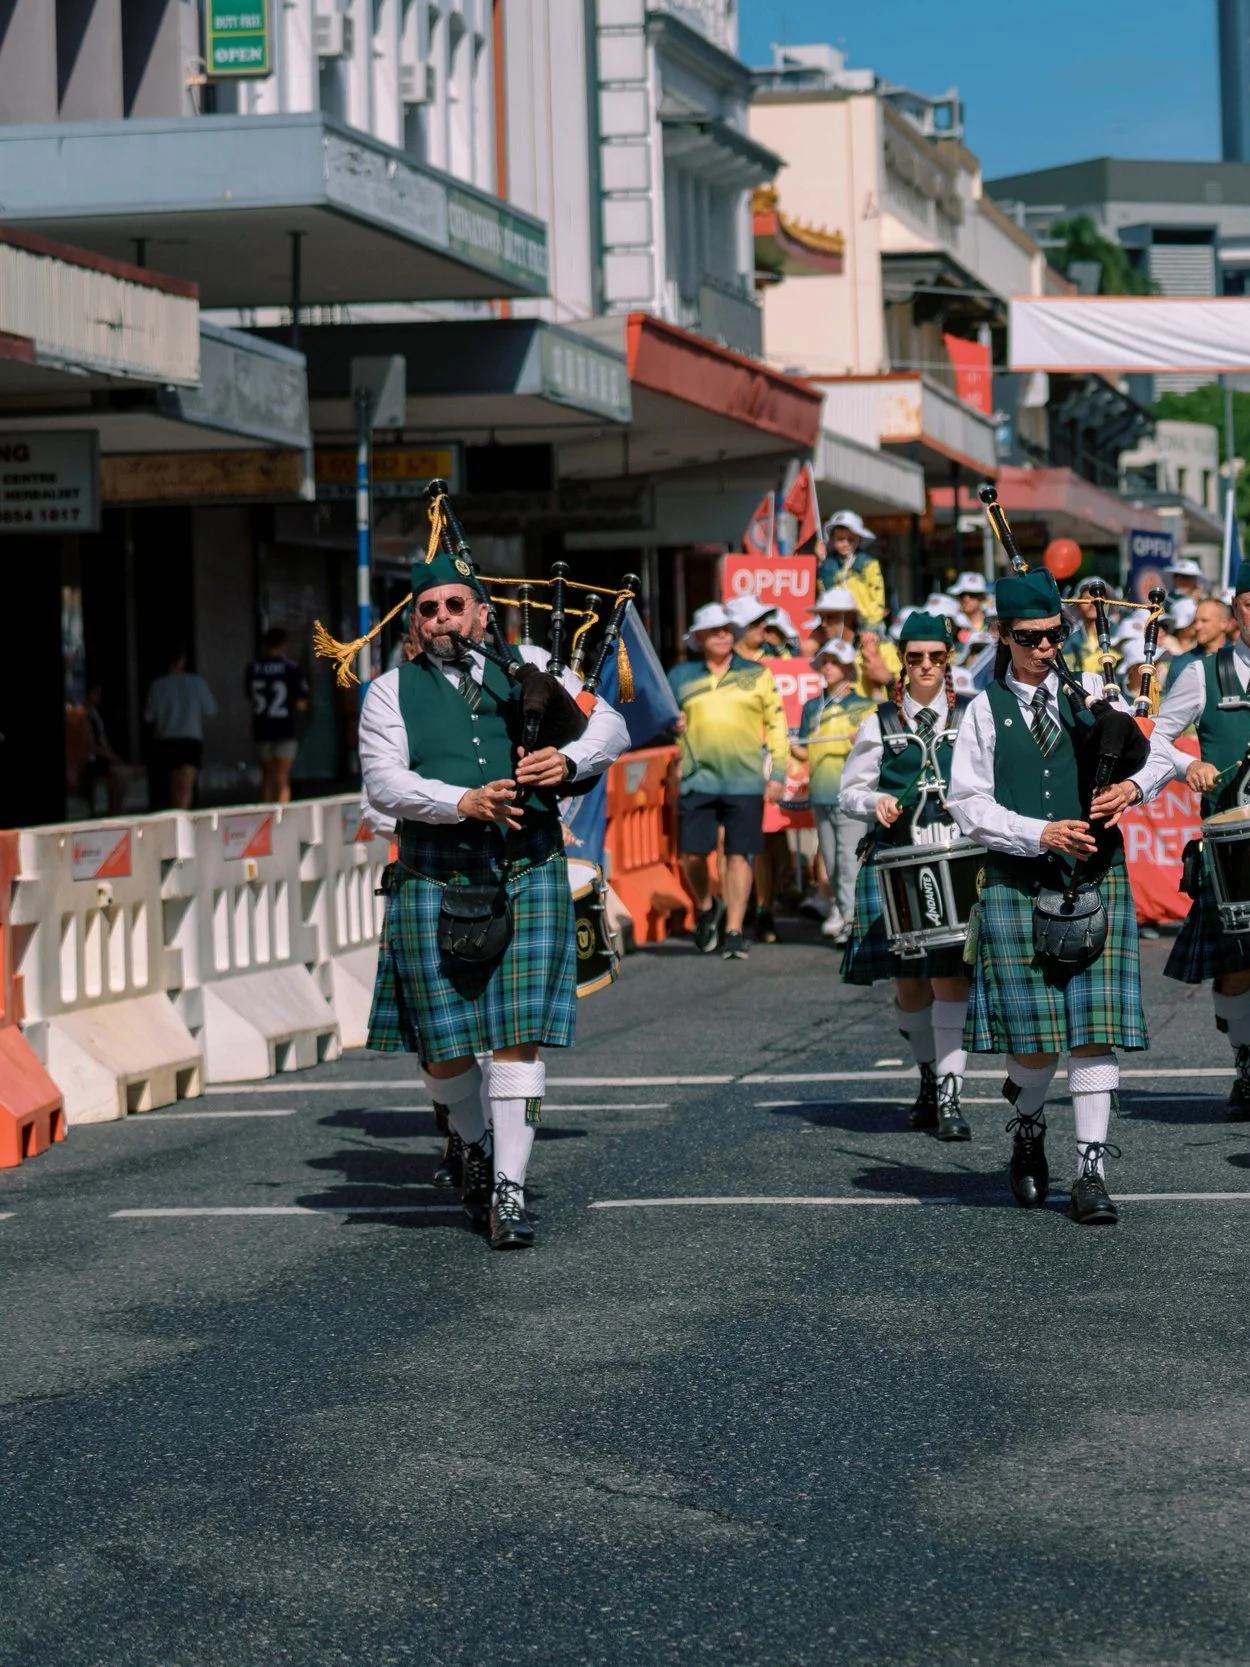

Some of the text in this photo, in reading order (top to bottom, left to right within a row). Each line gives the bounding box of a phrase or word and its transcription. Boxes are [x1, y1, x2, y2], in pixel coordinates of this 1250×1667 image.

[215, 46, 262, 62] OPEN
[1132, 536, 1173, 559] QPFU
[252, 681, 289, 718] 52
[923, 876, 942, 927] ANDANTE
